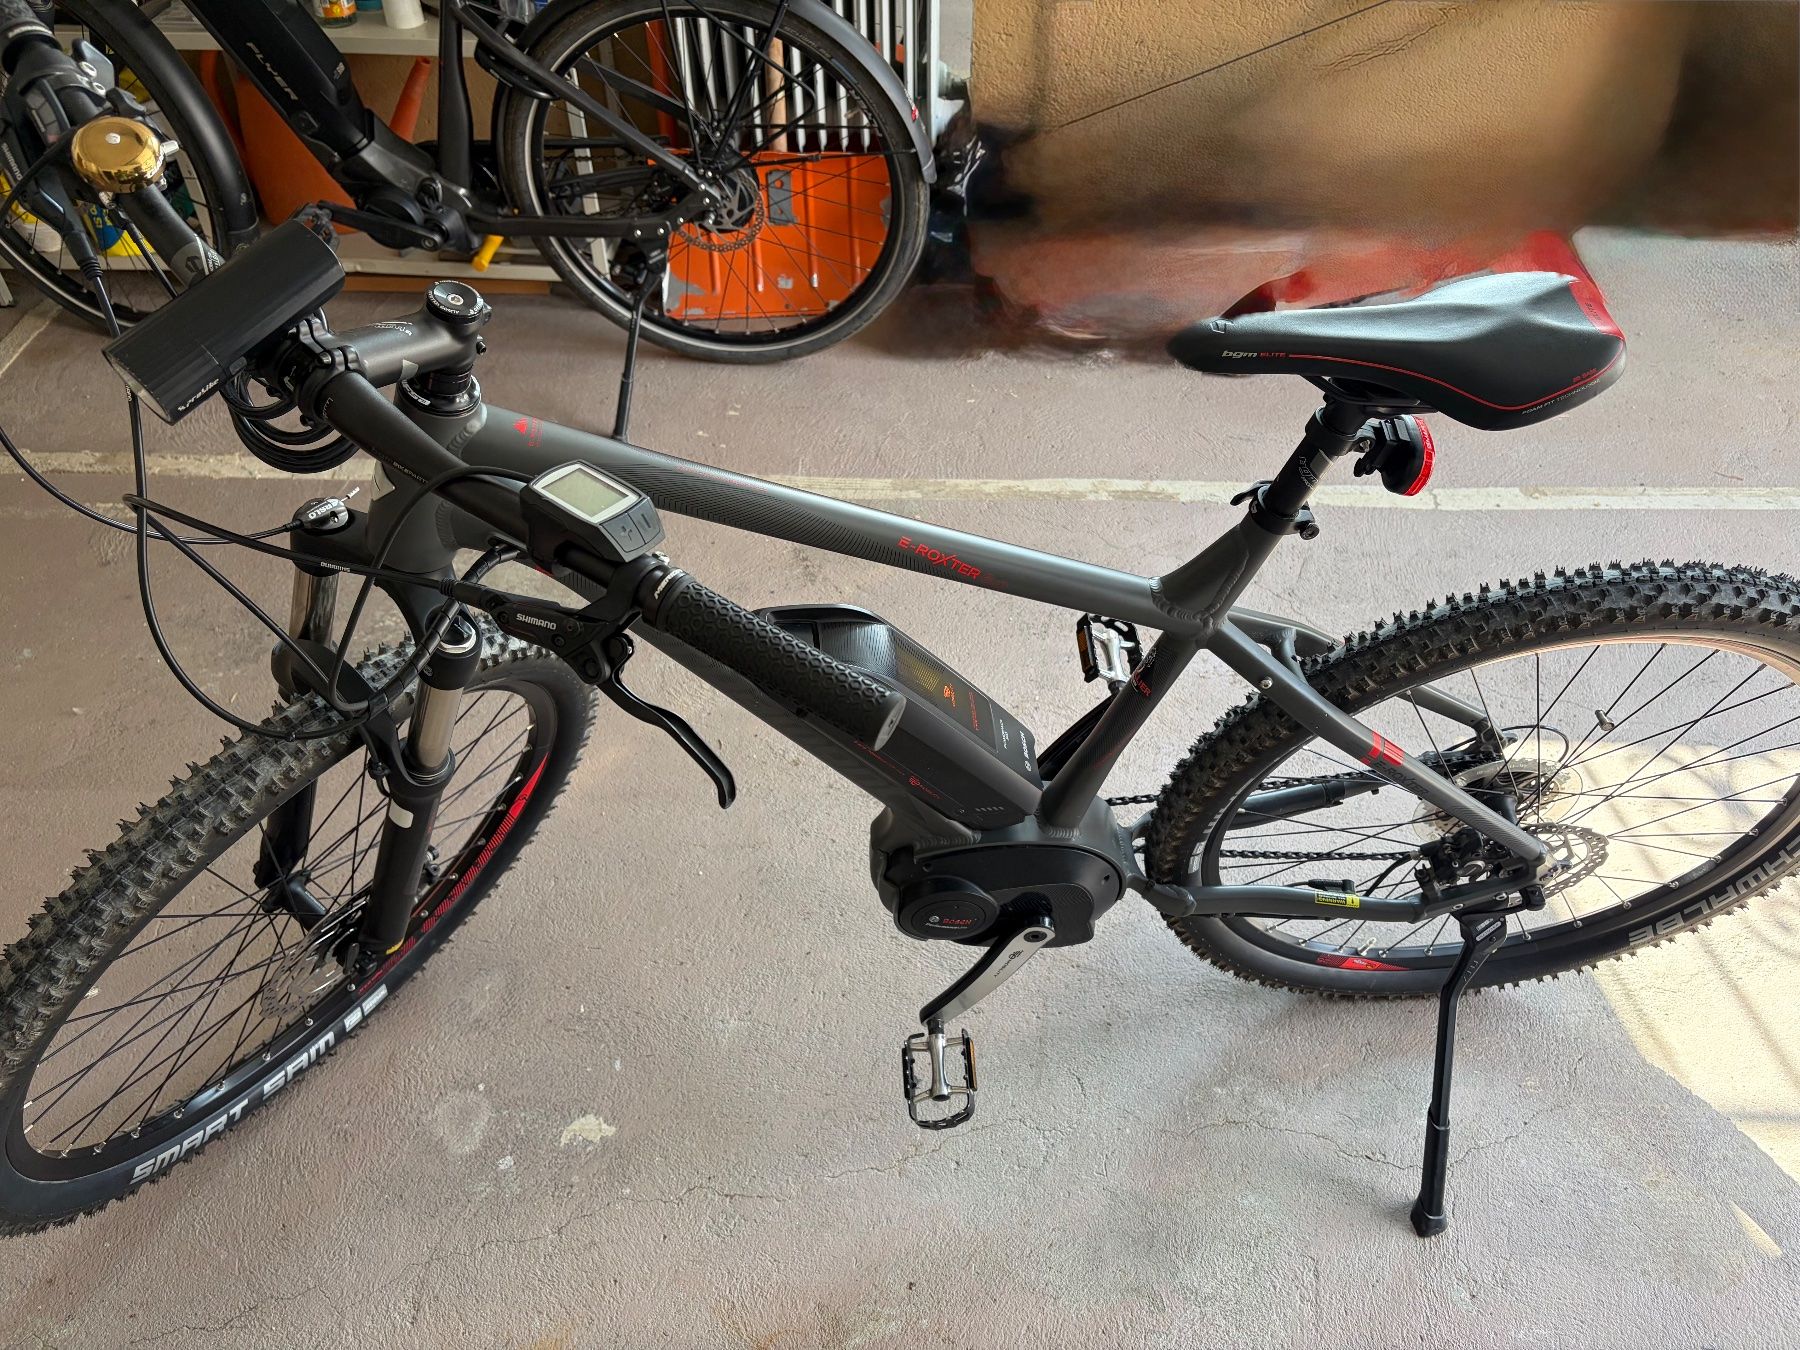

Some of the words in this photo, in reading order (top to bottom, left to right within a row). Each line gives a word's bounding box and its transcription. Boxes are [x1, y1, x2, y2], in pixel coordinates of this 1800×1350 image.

[246, 42, 299, 100] FLYER
[2, 142, 23, 180] SHIMANO
[1222, 350, 1258, 359] bgm
[897, 536, 981, 579] E-ROXTER
[516, 613, 557, 631] SHIMANO
[130, 1098, 249, 1185] SMART
[262, 1031, 336, 1100] SAM
